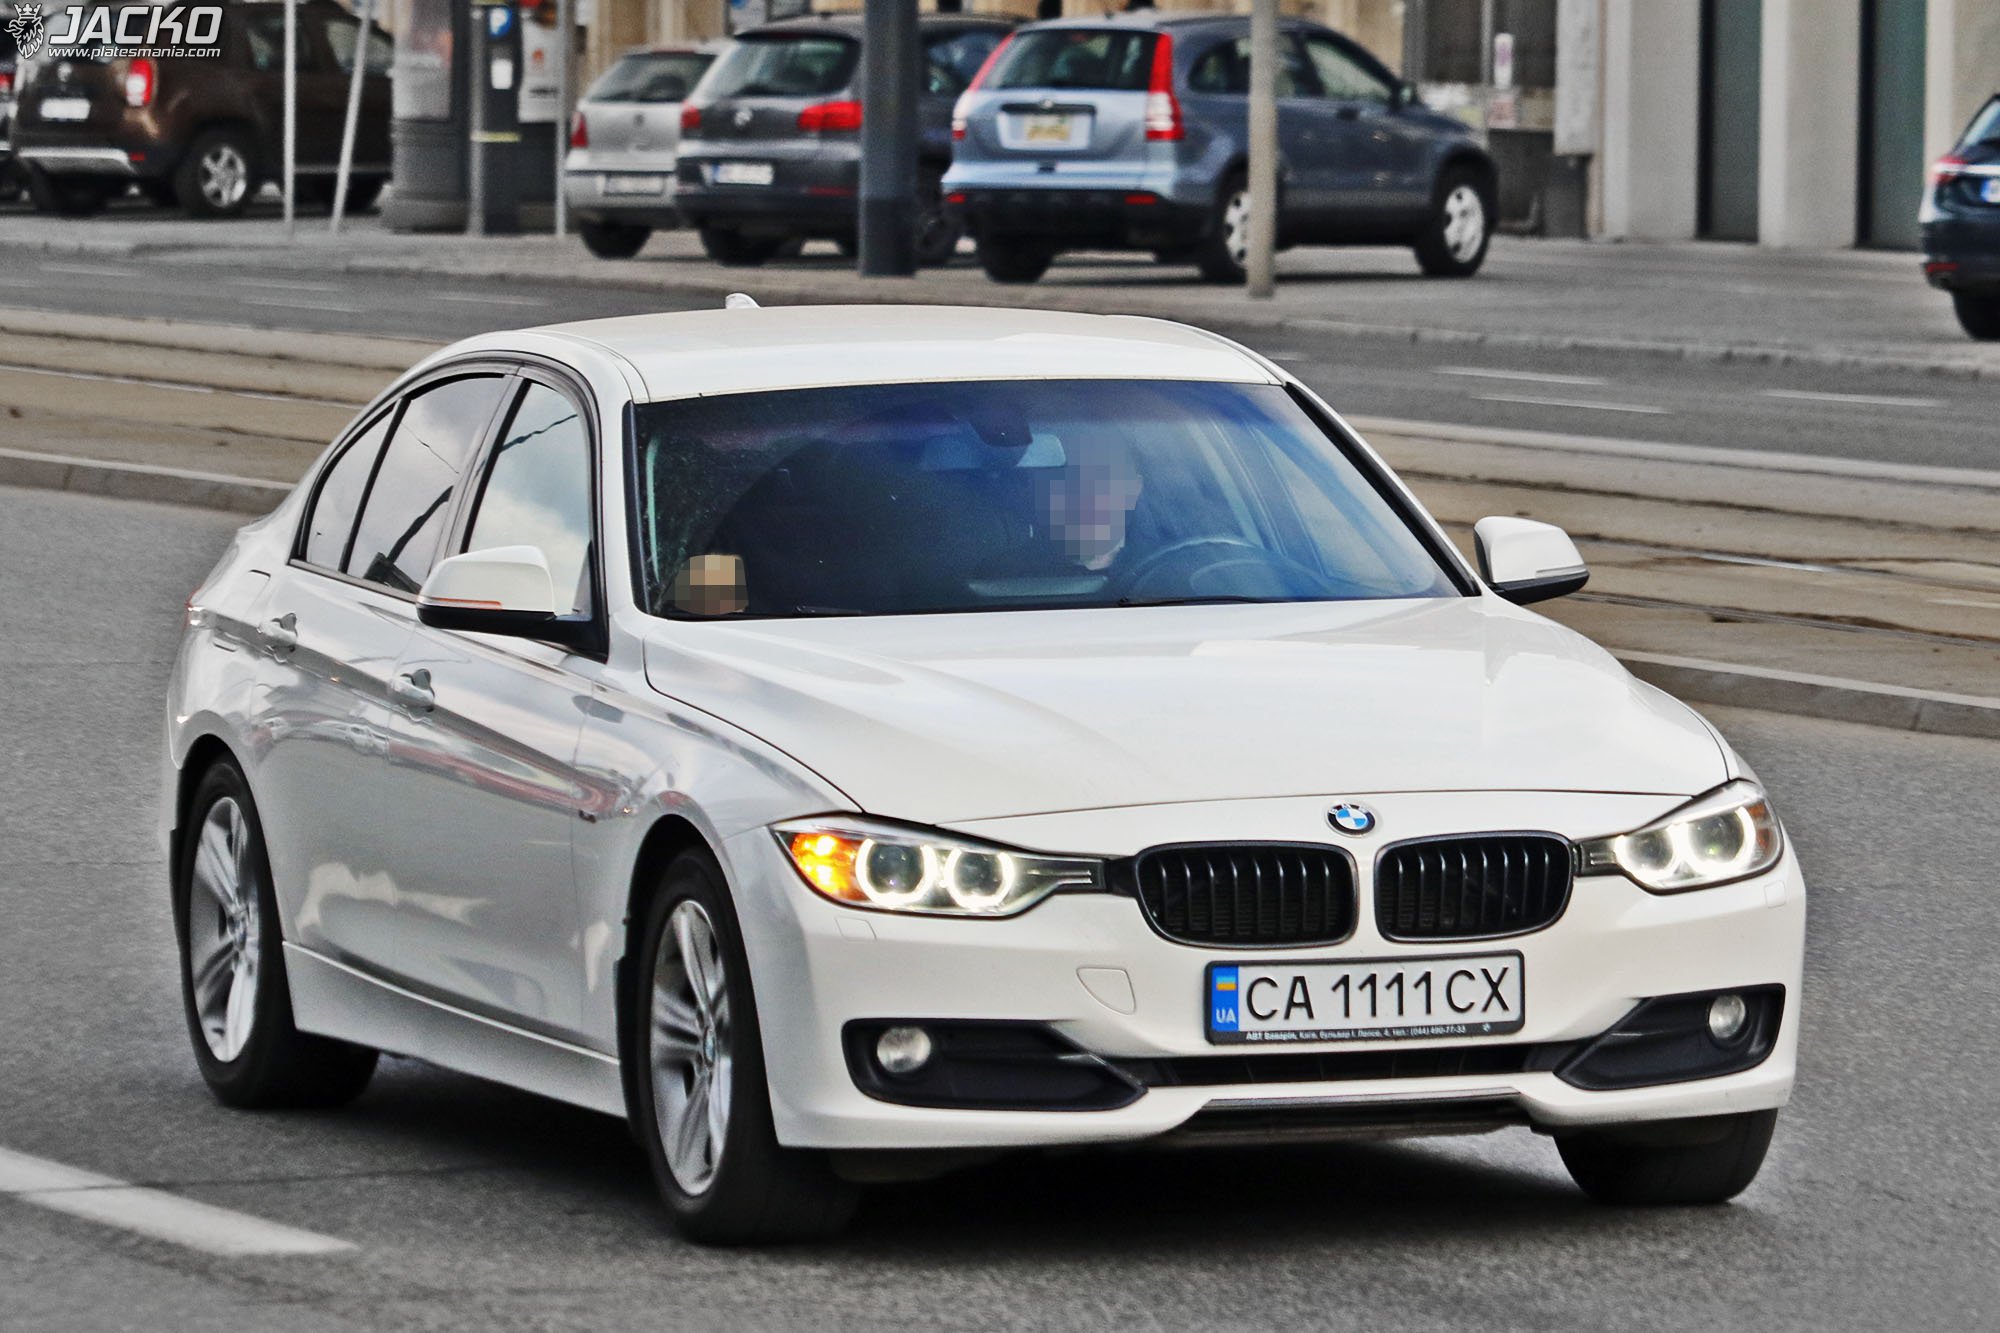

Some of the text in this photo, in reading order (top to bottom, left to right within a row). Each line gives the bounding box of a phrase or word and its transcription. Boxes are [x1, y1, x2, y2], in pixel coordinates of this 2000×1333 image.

[489, 7, 508, 35] P
[1246, 966, 1510, 1021] CA 1111 CX
[1215, 1008, 1237, 1025] UA
